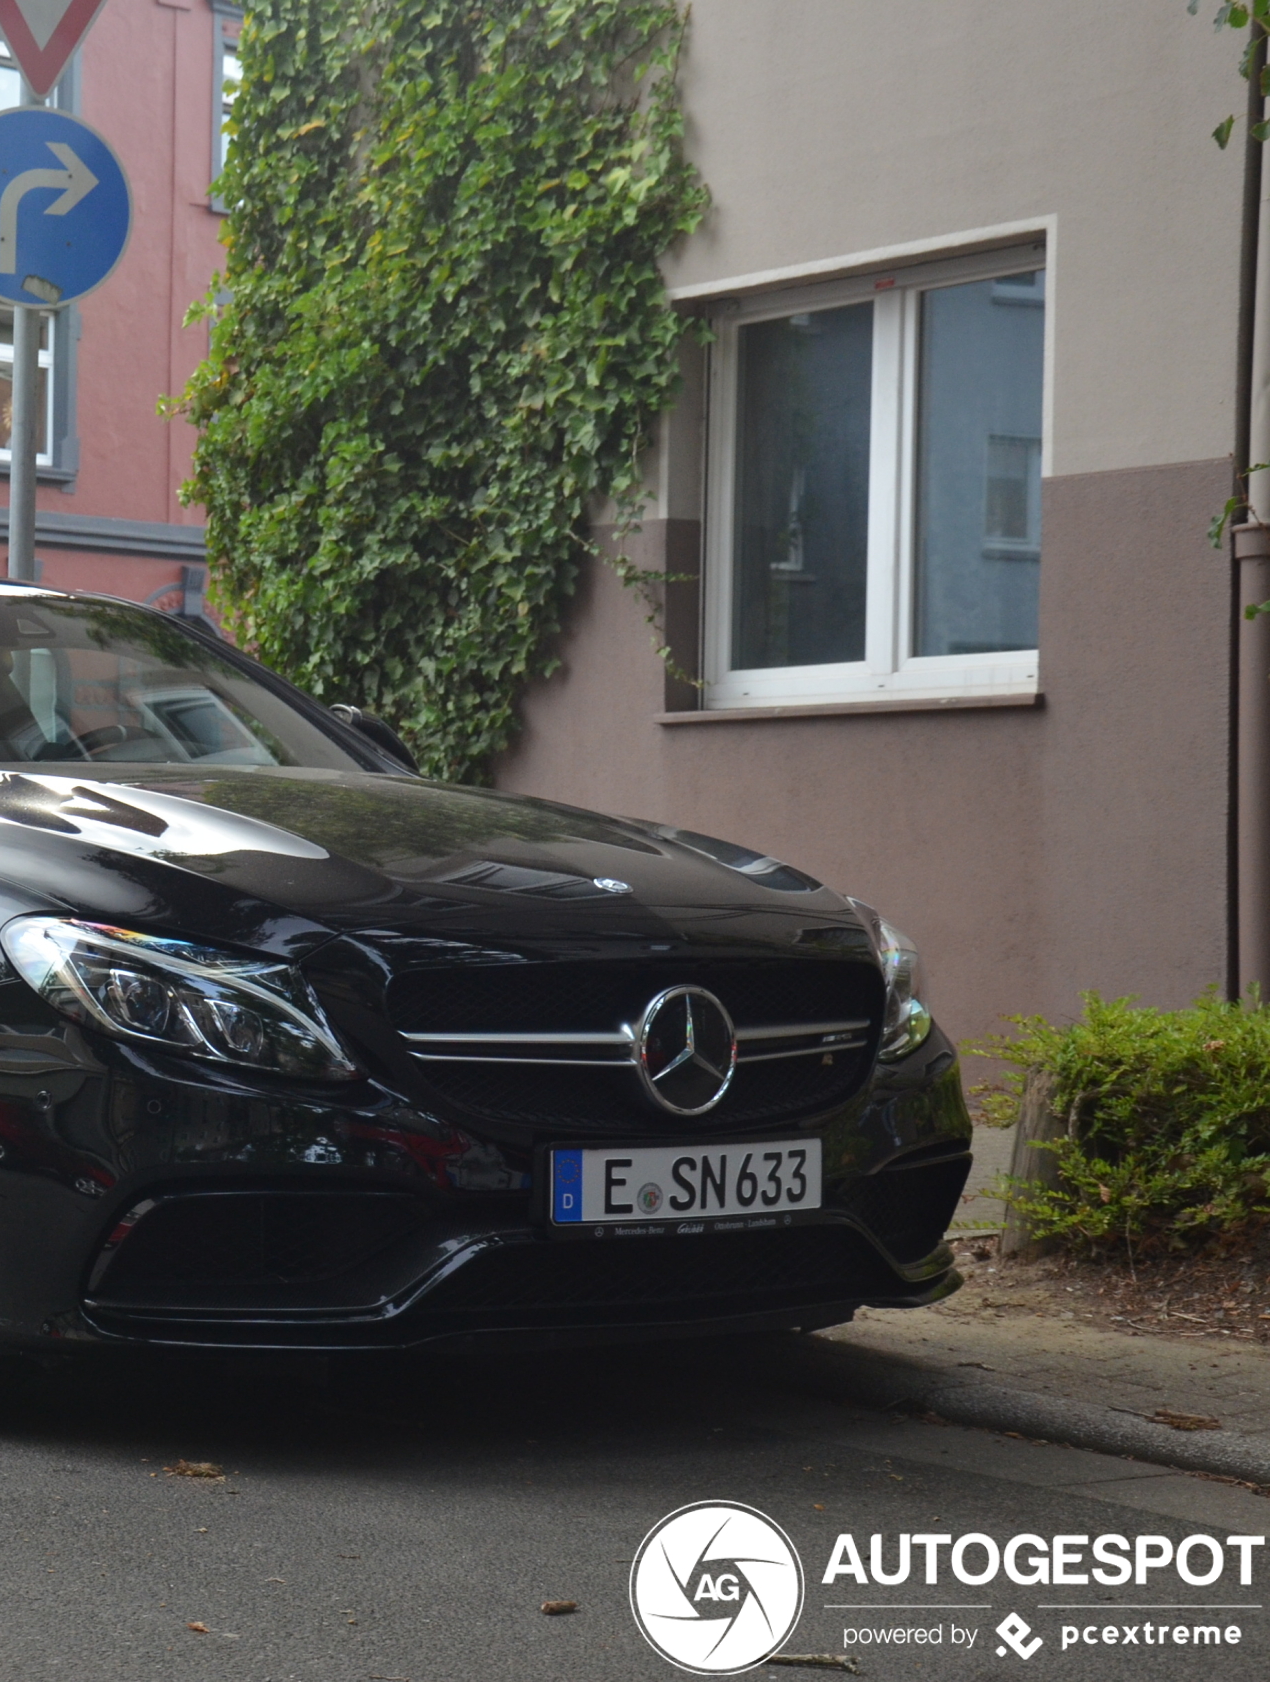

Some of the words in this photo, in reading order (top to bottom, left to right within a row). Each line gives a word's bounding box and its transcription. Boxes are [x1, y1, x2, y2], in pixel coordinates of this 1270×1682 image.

[604, 1158, 633, 1214] E
[563, 1194, 573, 1209] D
[614, 1227, 665, 1236] Mercedes-Benz
